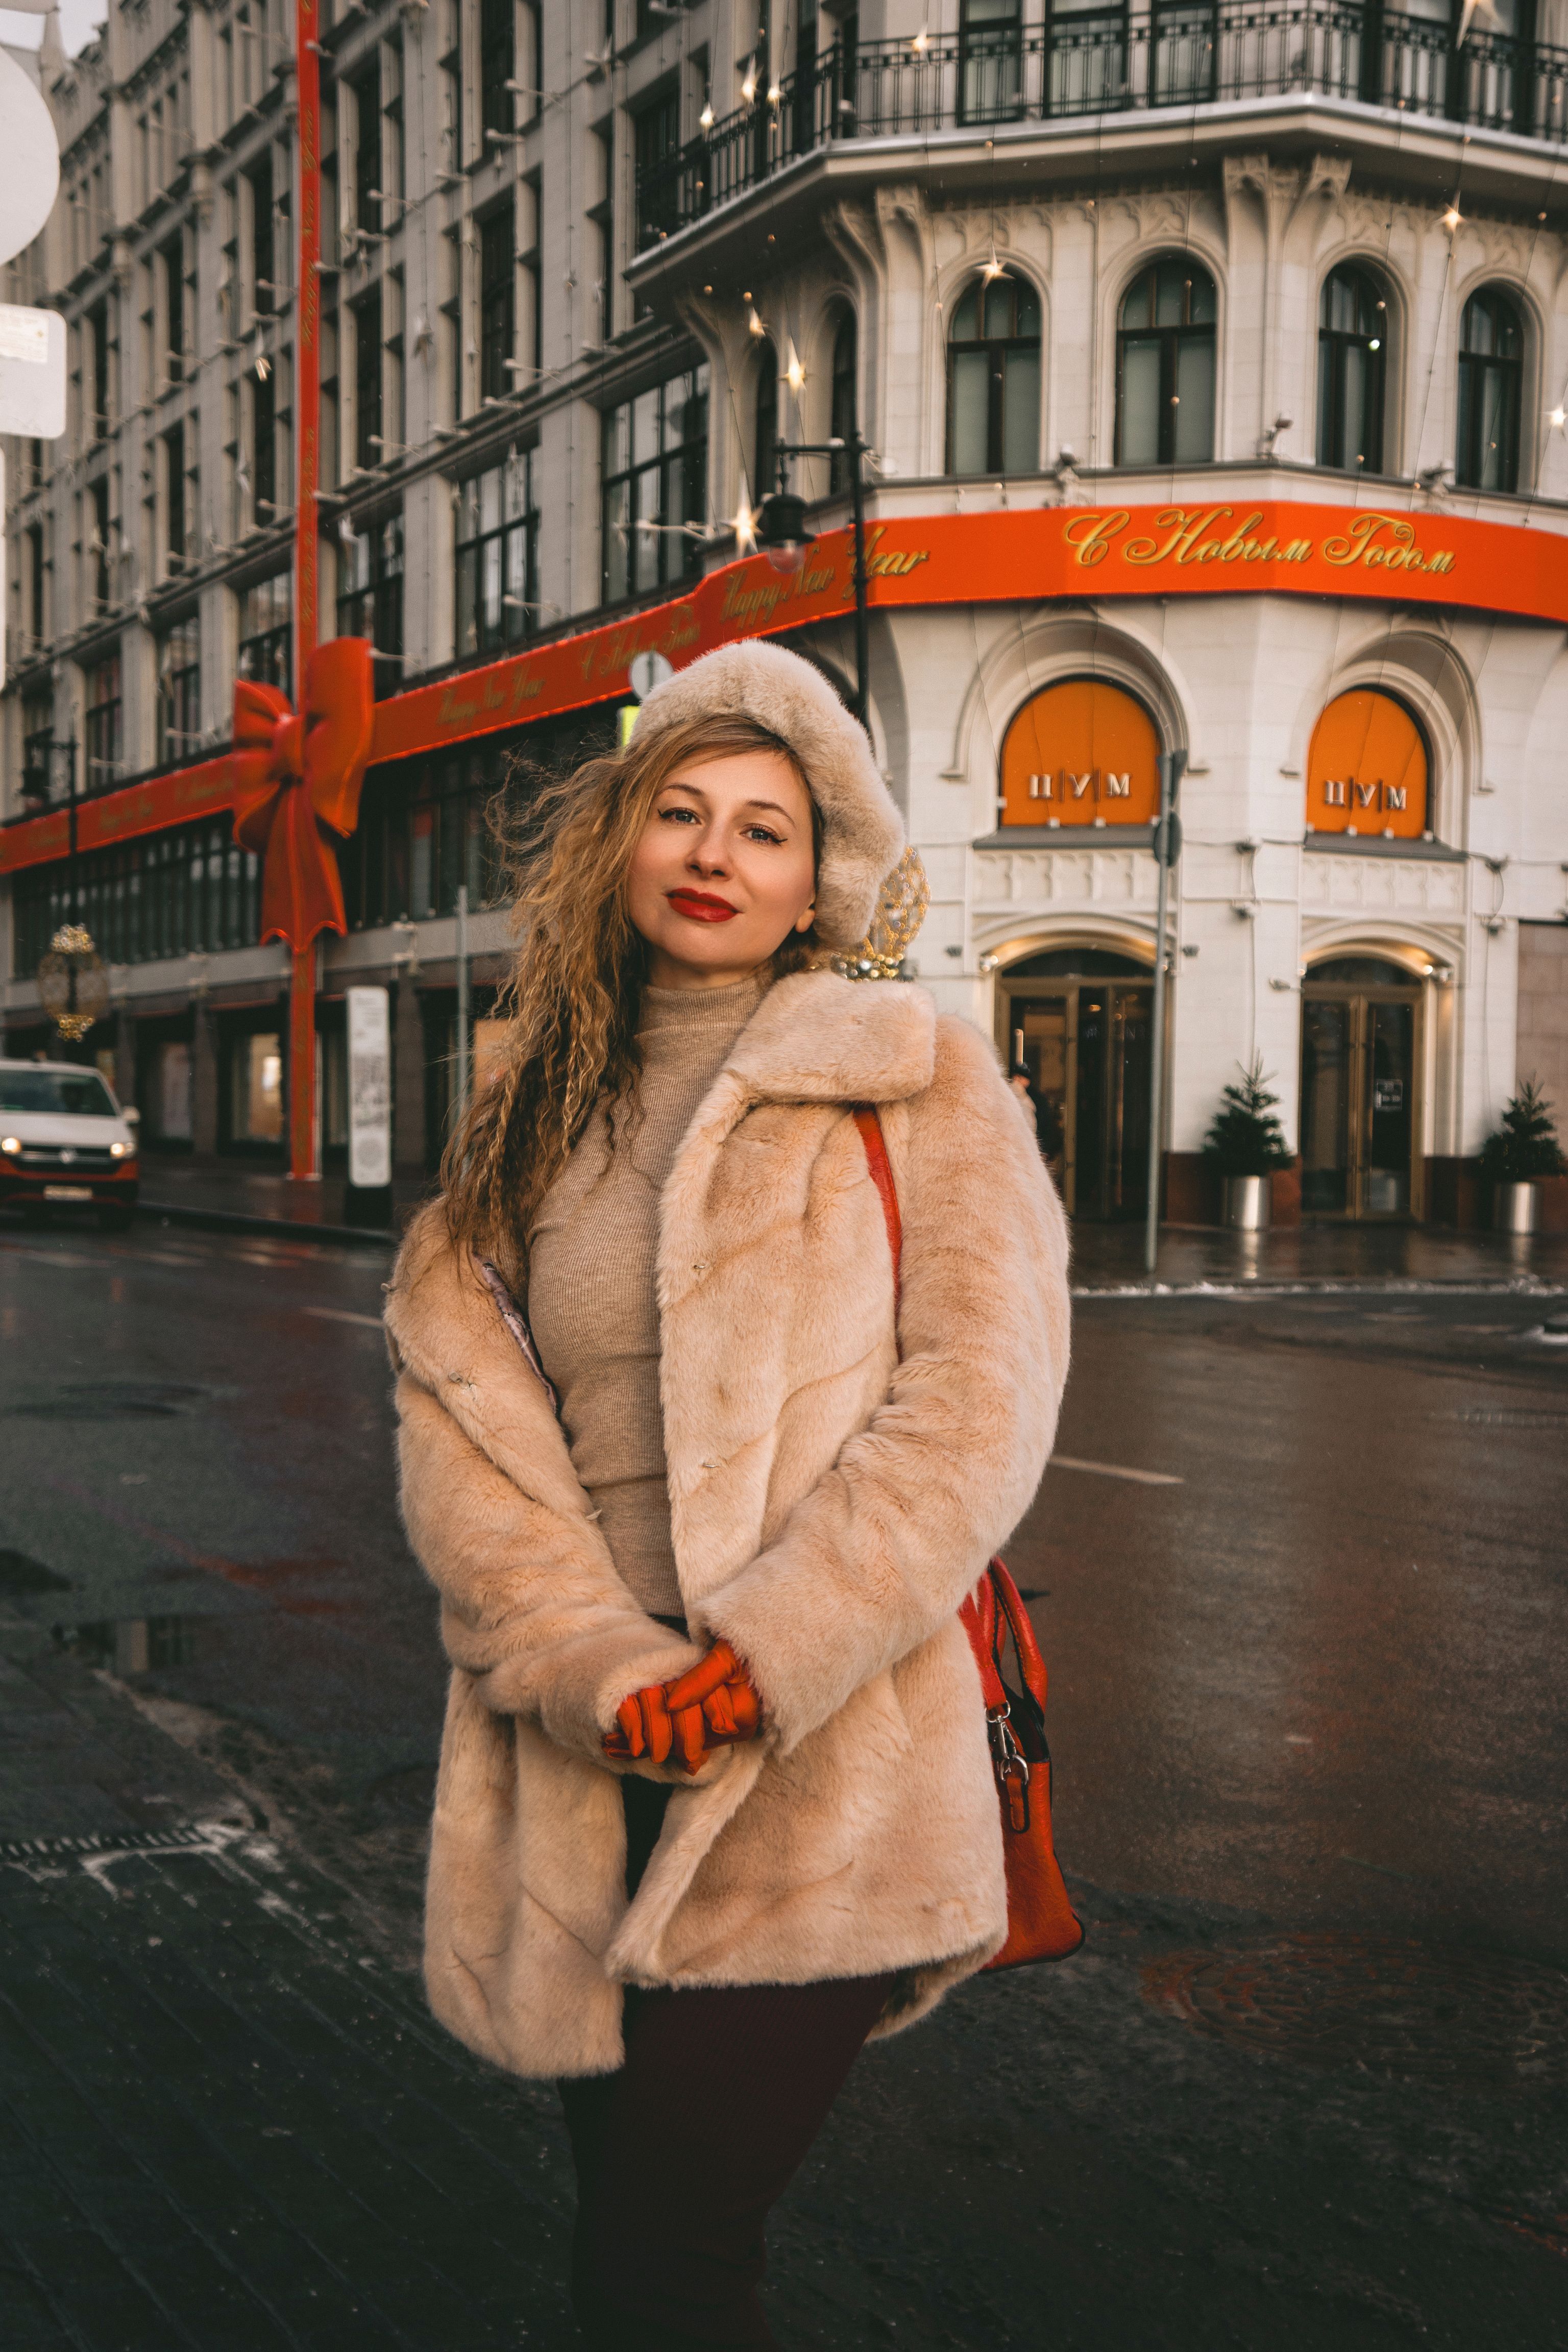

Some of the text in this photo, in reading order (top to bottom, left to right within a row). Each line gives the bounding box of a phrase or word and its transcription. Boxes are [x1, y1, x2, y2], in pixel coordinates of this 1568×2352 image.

[842, 526, 928, 600] Year
[1063, 506, 1456, 573] С Новым Годом
